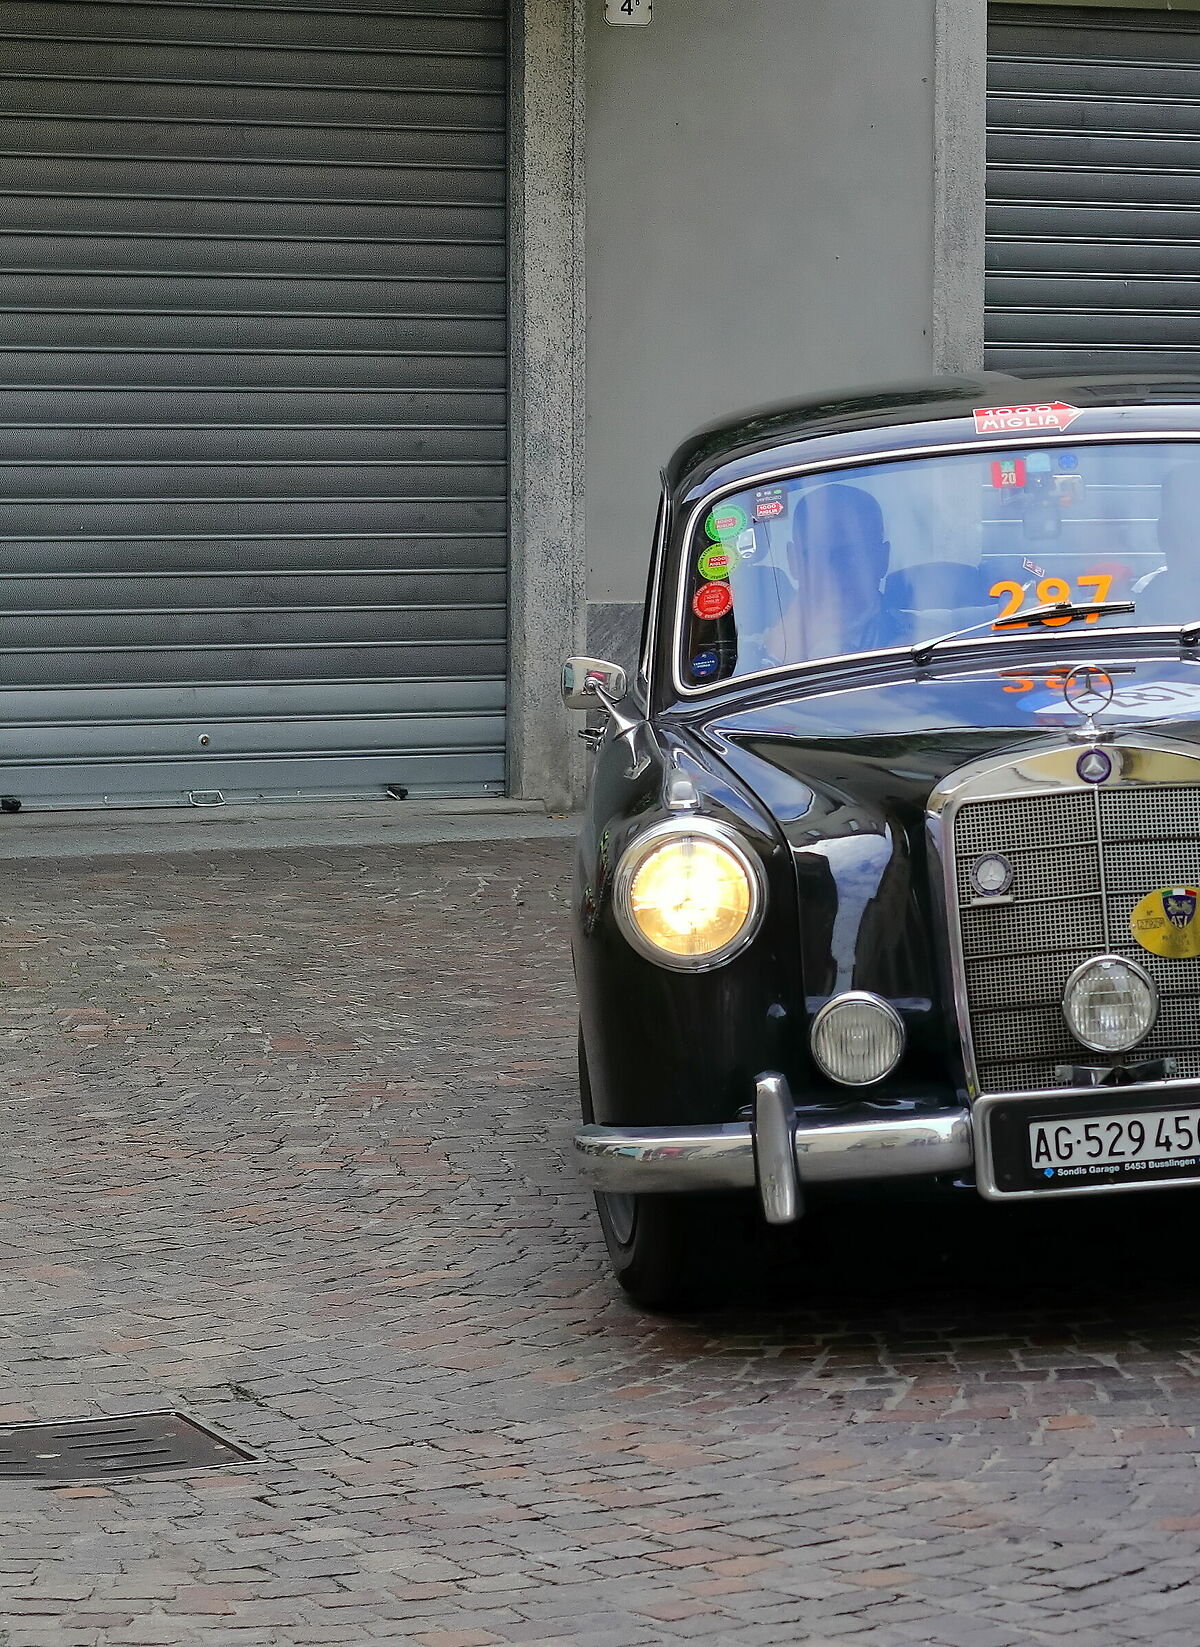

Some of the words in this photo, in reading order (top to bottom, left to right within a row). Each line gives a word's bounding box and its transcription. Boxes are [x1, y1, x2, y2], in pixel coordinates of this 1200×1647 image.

[984, 406, 1053, 418] 1000
[983, 415, 1060, 430] MIGLIA
[1001, 472, 1017, 485] 20
[989, 574, 1113, 631] 287
[1057, 1166, 1086, 1176] Sondis
[1089, 1165, 1120, 1175] Garage
[1125, 1161, 1146, 1171] 5453
[1148, 1157, 1196, 1169] Busslingen
